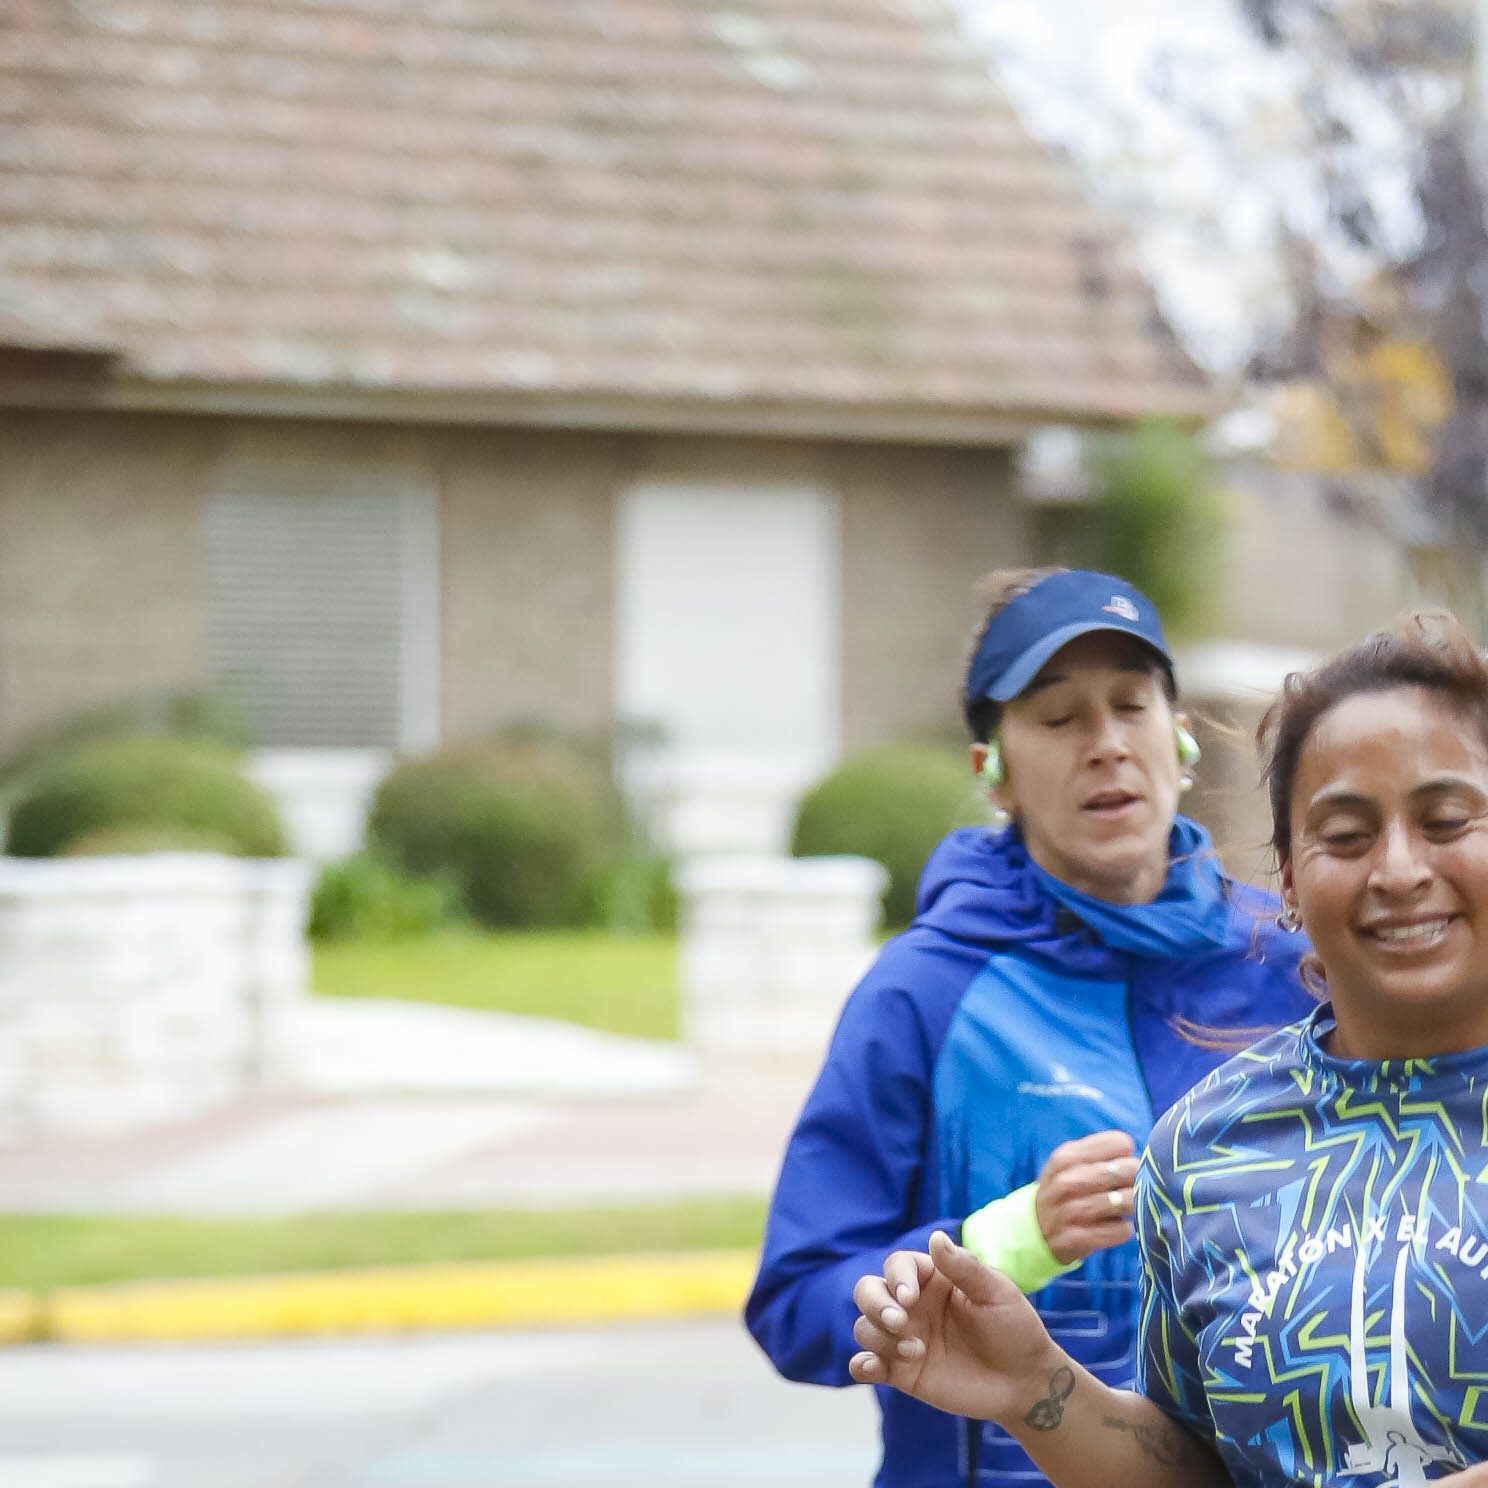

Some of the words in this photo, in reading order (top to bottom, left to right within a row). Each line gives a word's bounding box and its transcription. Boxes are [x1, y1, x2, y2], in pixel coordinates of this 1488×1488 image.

[1234, 1223, 1351, 1369] MARATÓN
[1365, 1214, 1387, 1242] X
[1396, 1214, 1429, 1242] EL
